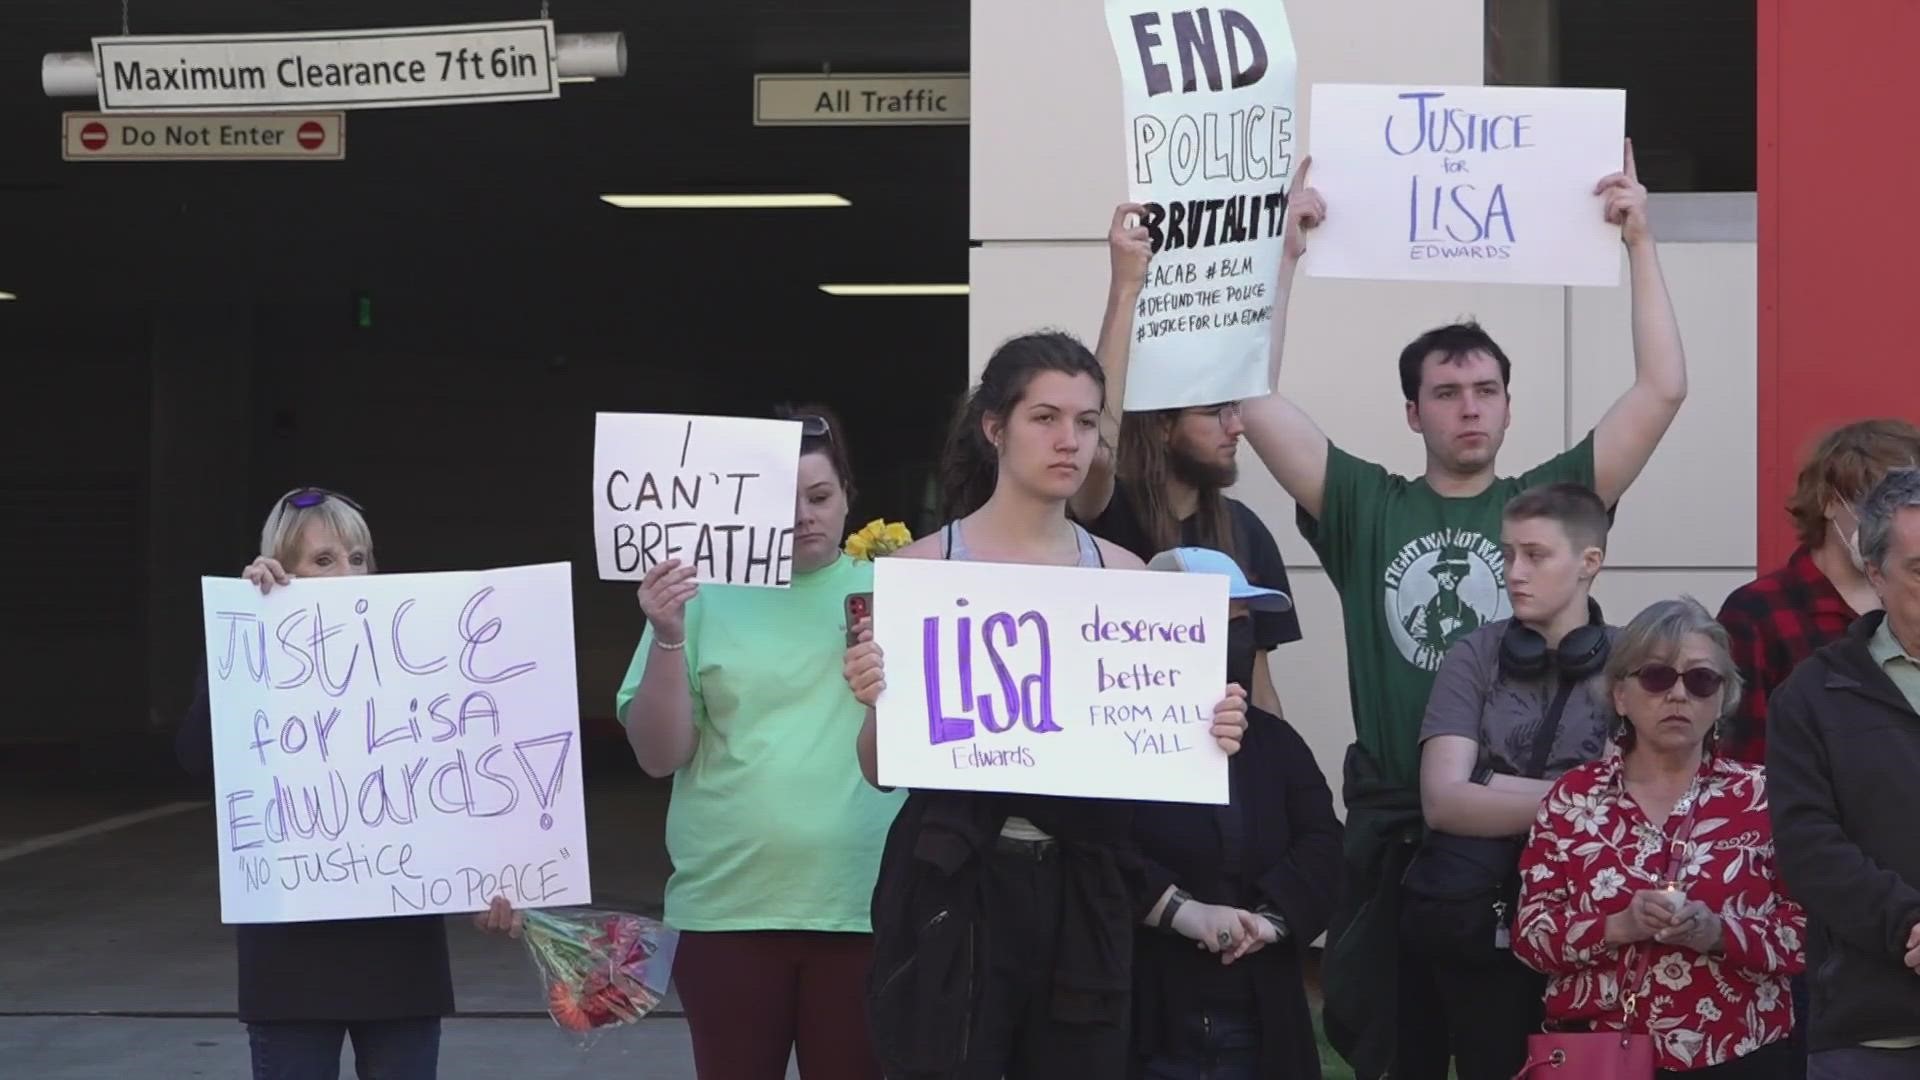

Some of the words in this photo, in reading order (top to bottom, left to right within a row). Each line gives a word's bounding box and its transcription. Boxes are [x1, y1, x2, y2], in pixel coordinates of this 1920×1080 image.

[114, 58, 265, 90] Maximum
[277, 55, 425, 87] Clearance
[436, 47, 484, 81] 7ft
[490, 46, 537, 78] 6in
[1130, 7, 1268, 97] END
[815, 90, 850, 112] All
[861, 89, 947, 112] Traffic
[122, 126, 155, 145] Do
[166, 126, 210, 145] Not
[220, 126, 285, 145] Enter
[1134, 105, 1292, 186] POLICE
[1140, 185, 1289, 254] BRUTALITY
[1205, 256, 1253, 280] #BLM
[1410, 245, 1511, 260] EDWARDS
[680, 420, 692, 468] I
[607, 470, 760, 514] CAN'T
[1384, 539, 1422, 587] FIGHT
[923, 598, 1064, 745] Lisa
[1081, 604, 1206, 643] deserved
[1098, 658, 1182, 693] better
[1089, 704, 1153, 726] FROM
[1161, 704, 1210, 724] ALL
[250, 707, 342, 765] for
[1123, 728, 1193, 755] Y'ALL
[952, 744, 1036, 768] Edwards
[392, 878, 452, 912] NO
